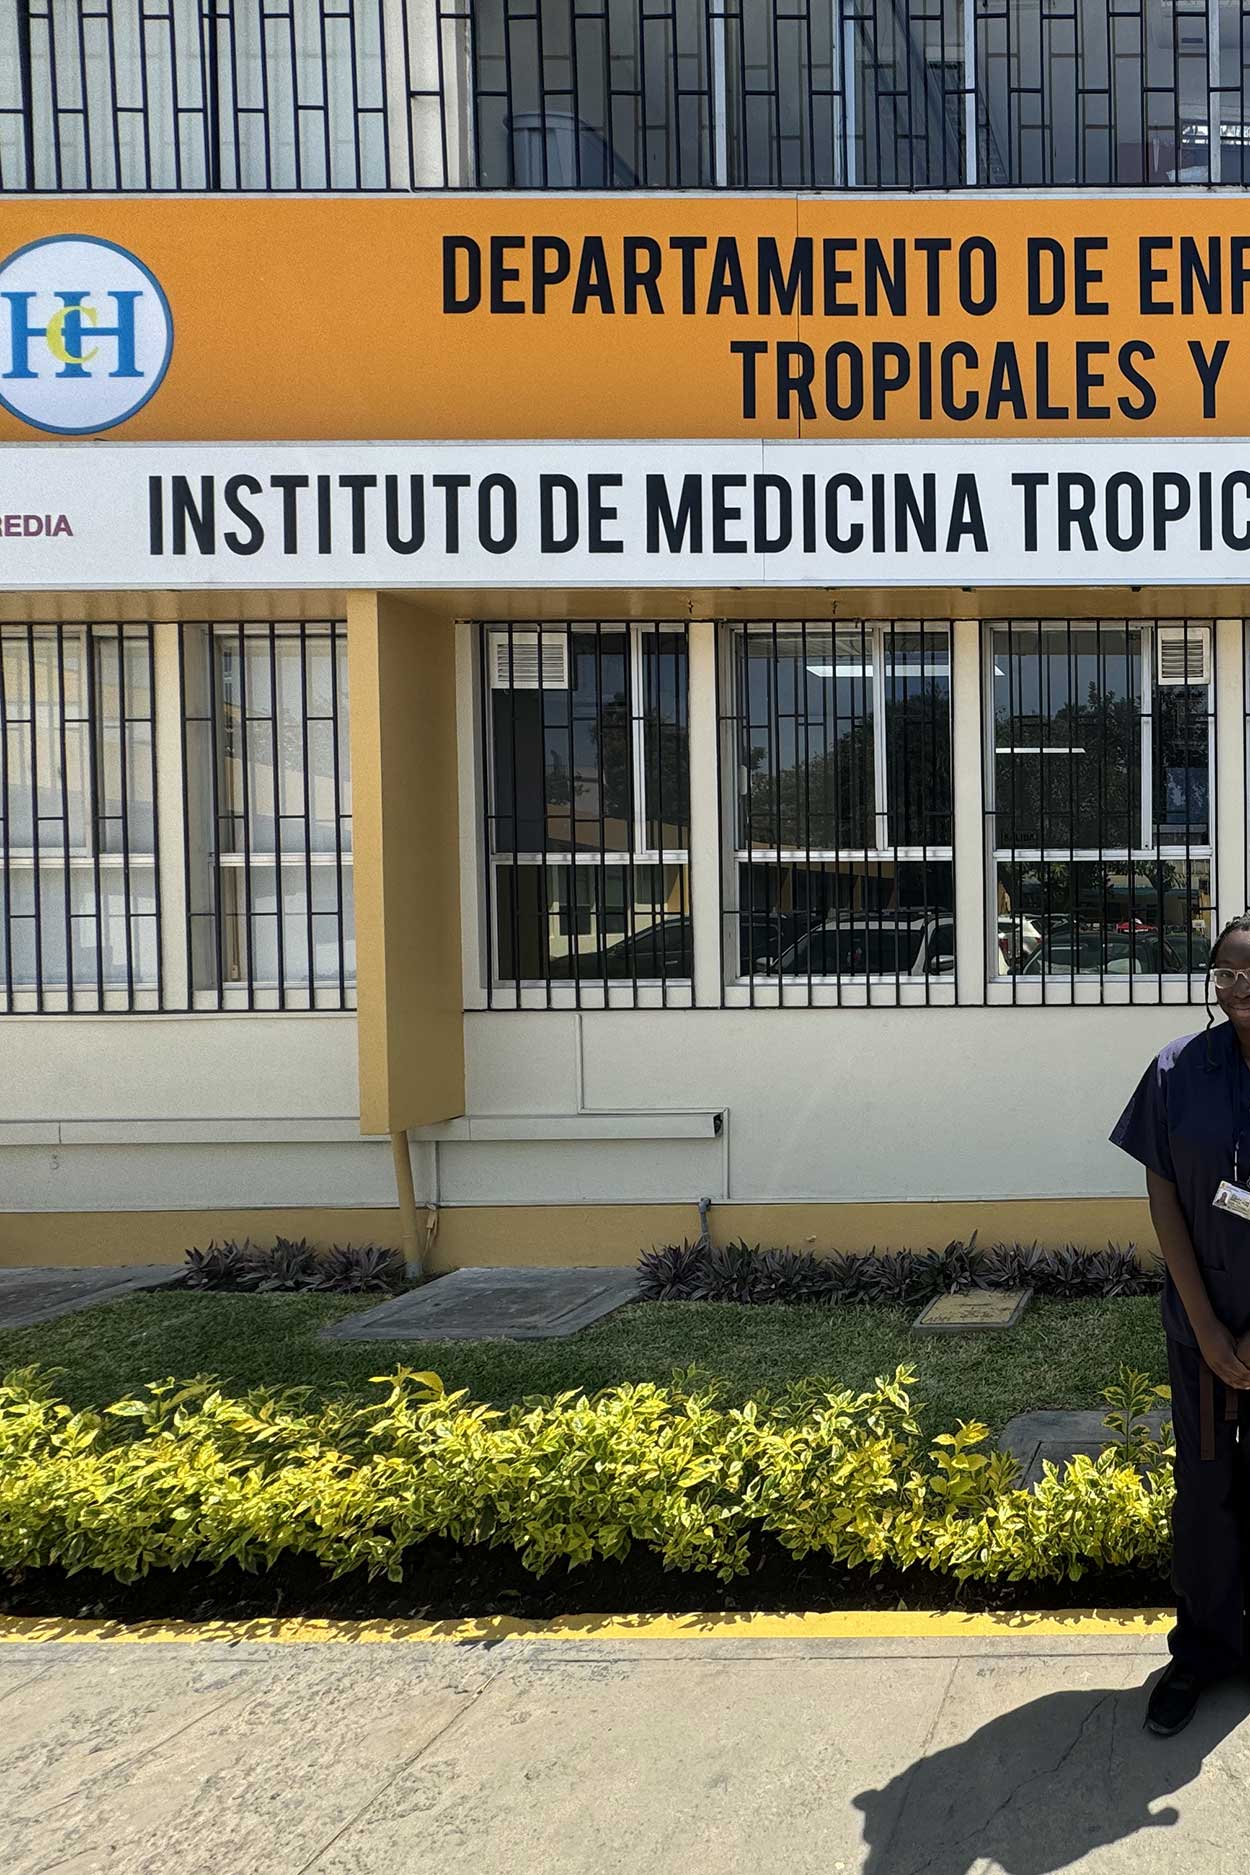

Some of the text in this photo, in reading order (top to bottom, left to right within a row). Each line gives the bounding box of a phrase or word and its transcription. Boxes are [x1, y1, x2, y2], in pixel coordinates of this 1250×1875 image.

[443, 236, 996, 316] DEPARTAMENTO
[1028, 237, 1108, 315] DE
[731, 340, 1156, 421] TROPICALES
[1188, 341, 1229, 418] Y
[0, 515, 73, 537] EDIA
[149, 474, 517, 555] INSTITUTO
[540, 474, 623, 553] DE
[646, 473, 988, 553] MEDICINA
